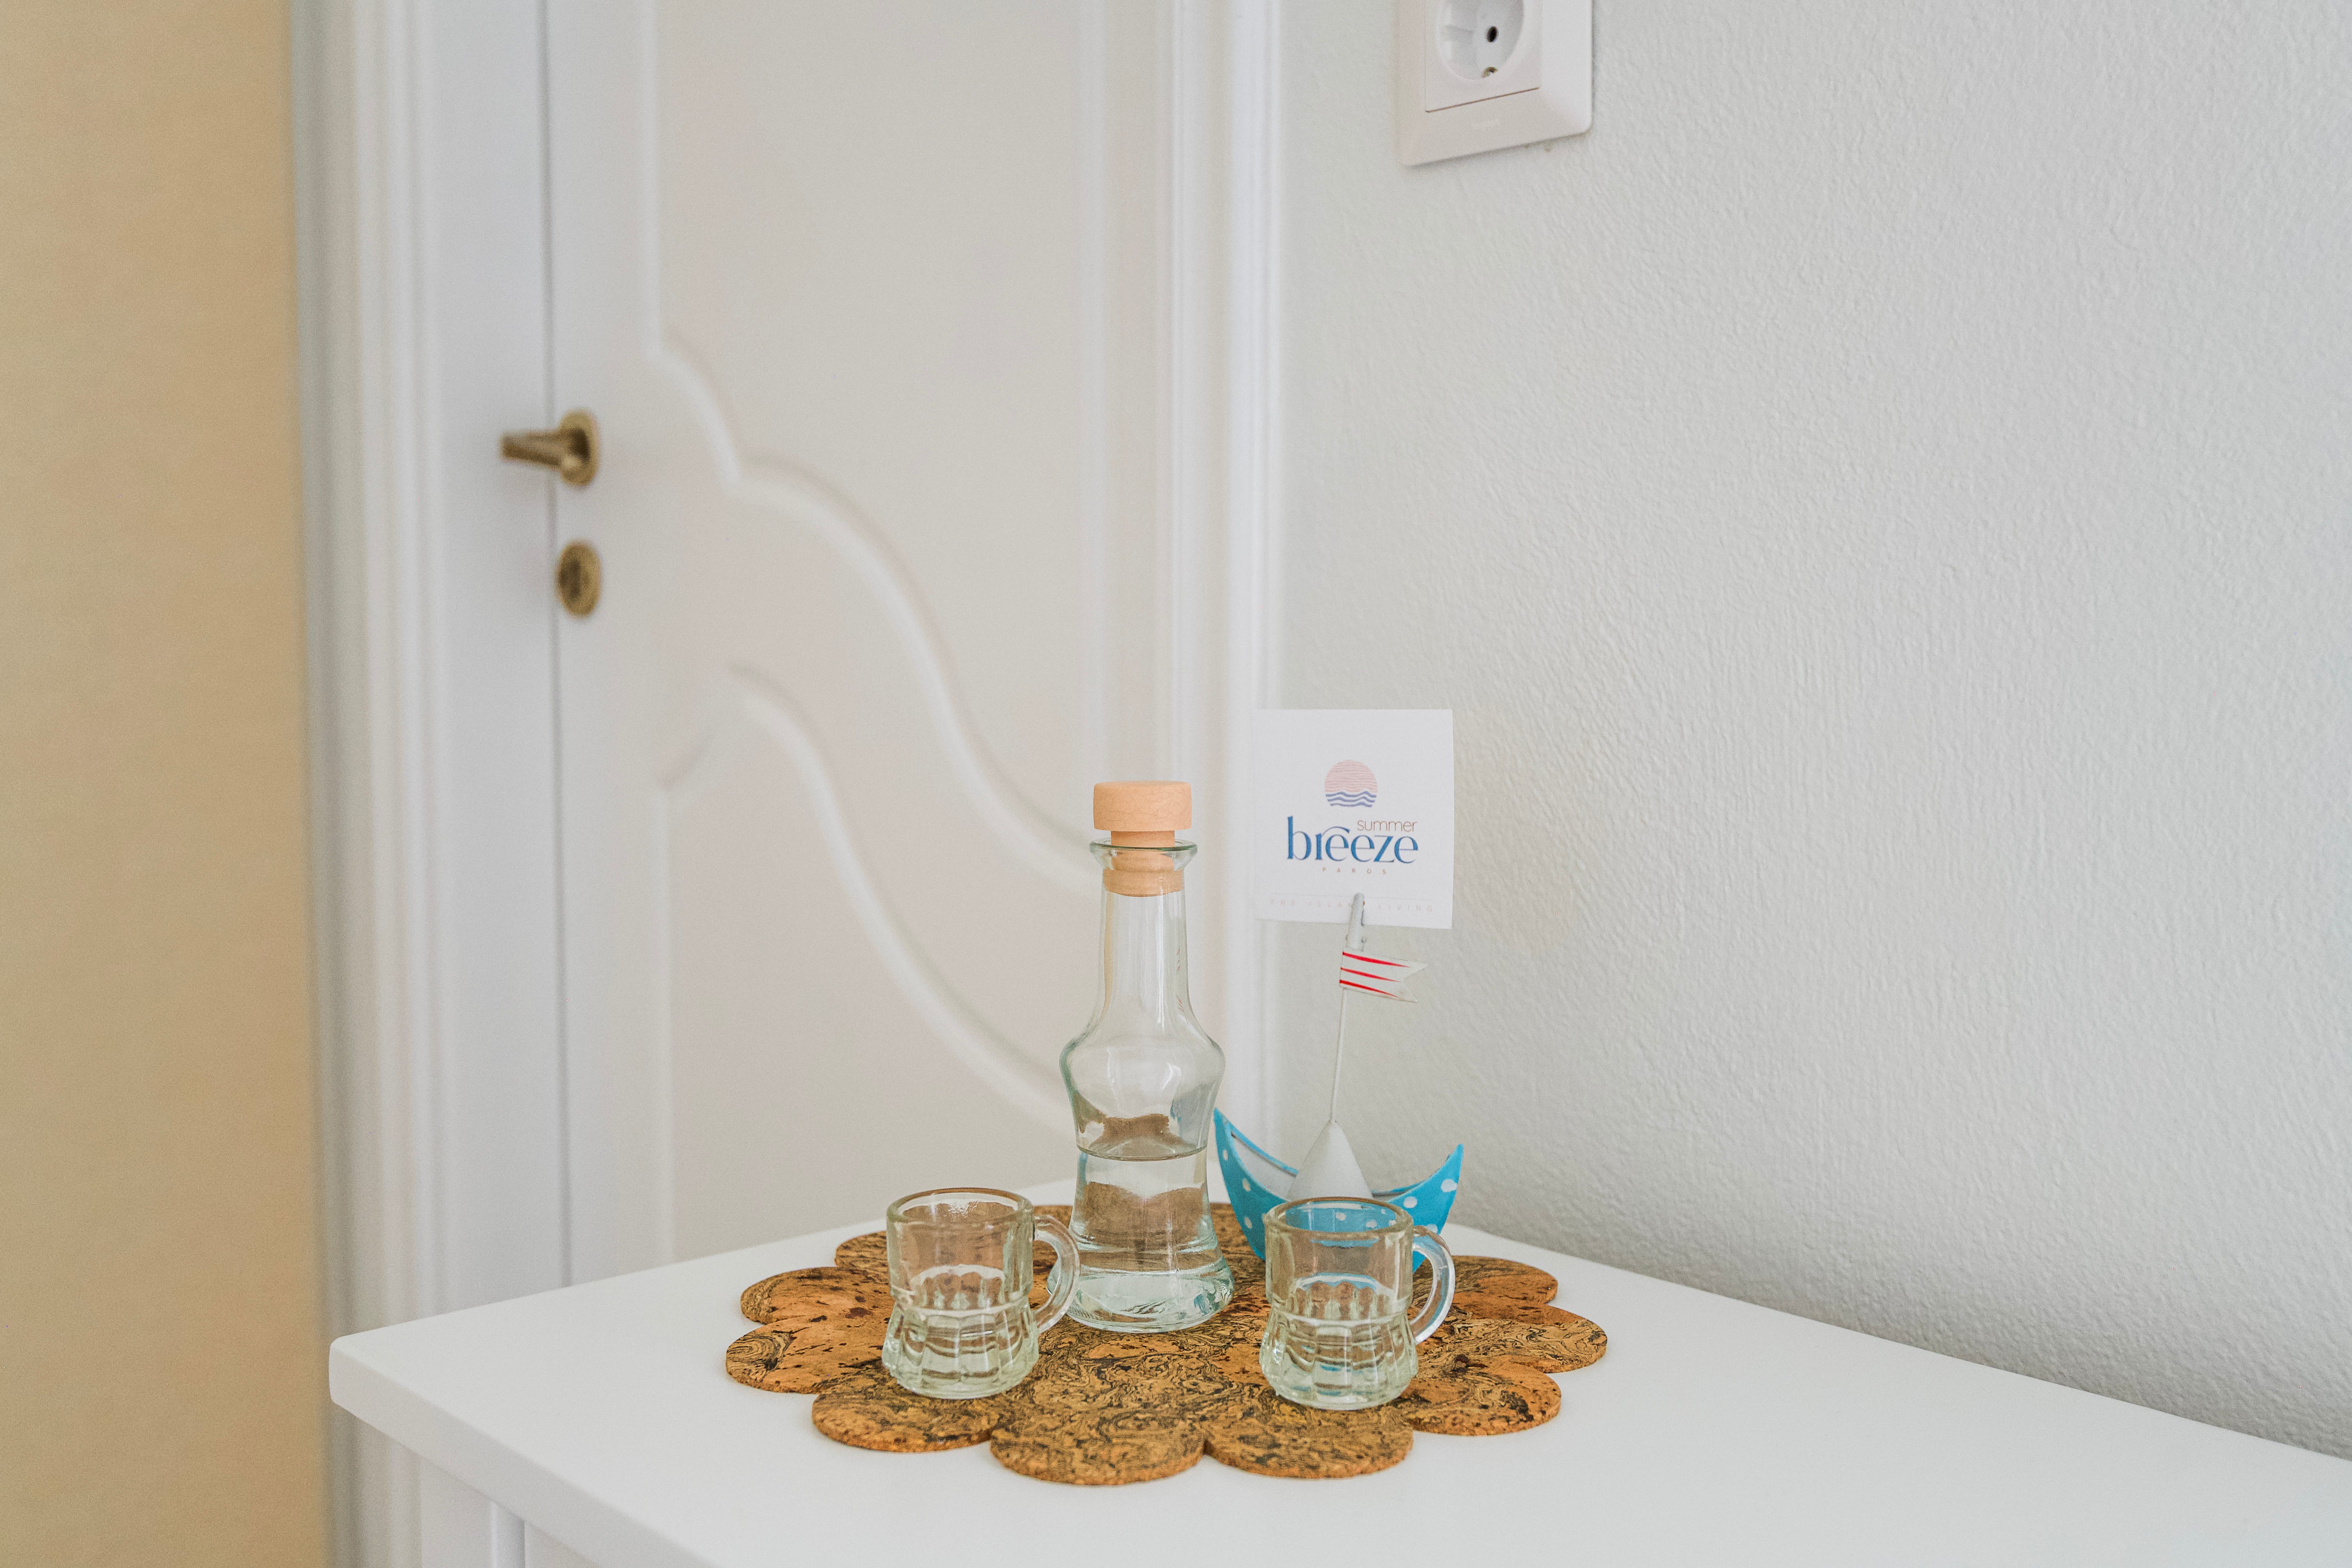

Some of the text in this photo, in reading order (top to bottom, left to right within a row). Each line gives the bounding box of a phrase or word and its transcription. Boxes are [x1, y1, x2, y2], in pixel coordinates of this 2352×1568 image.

[1357, 819, 1417, 832] summer
[1287, 816, 1419, 863] breeze
[1378, 903, 1433, 912] LIVING
